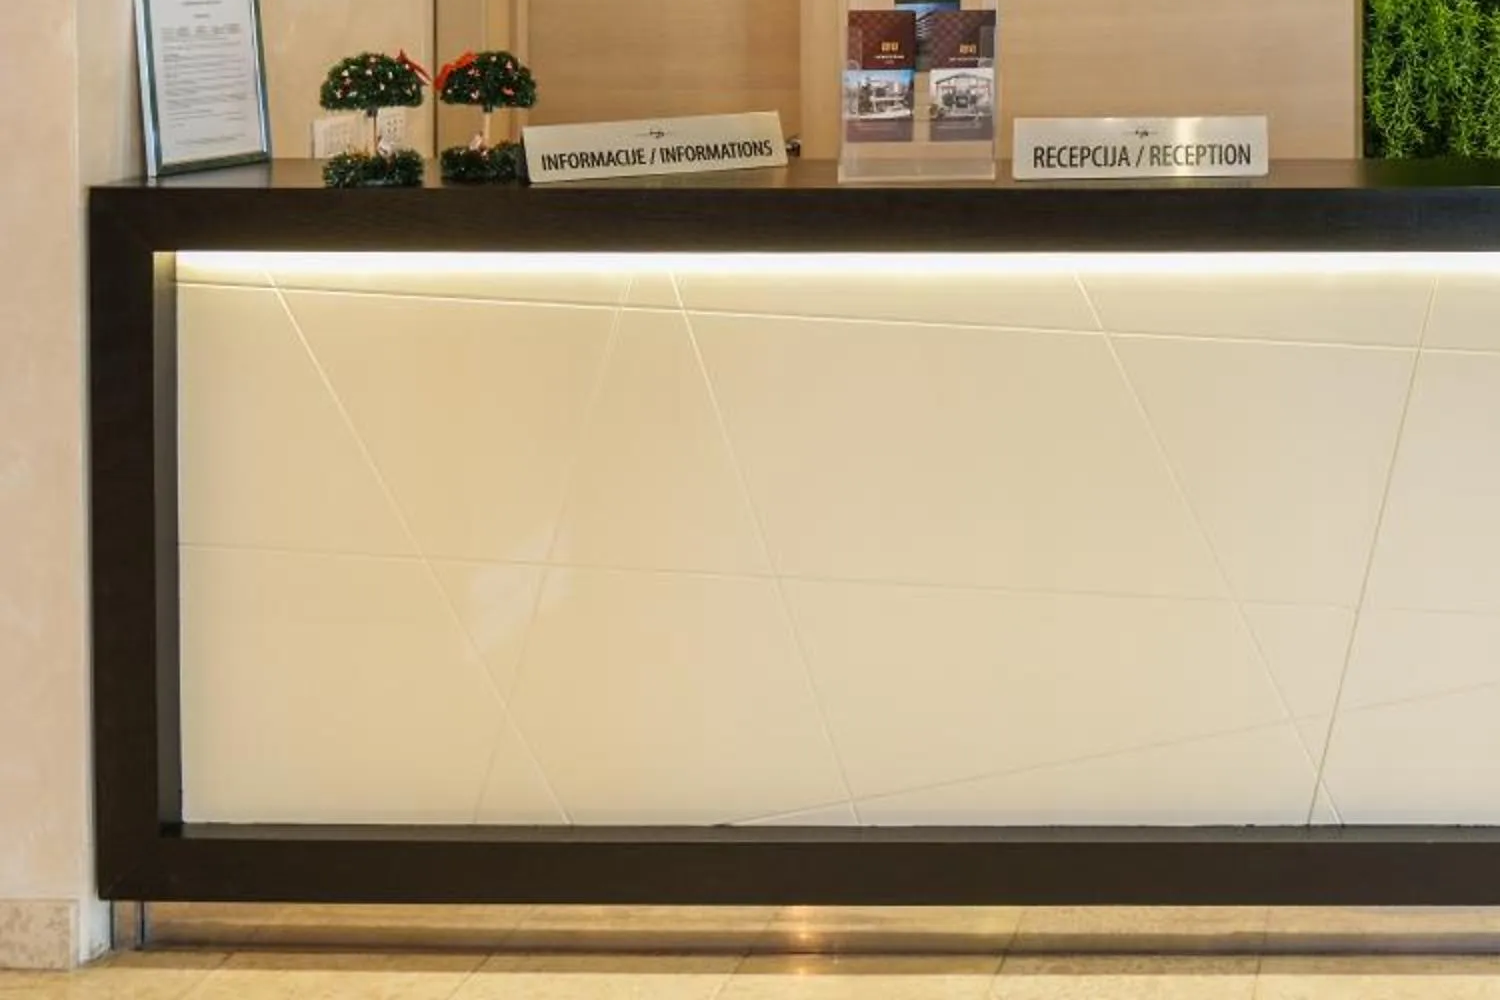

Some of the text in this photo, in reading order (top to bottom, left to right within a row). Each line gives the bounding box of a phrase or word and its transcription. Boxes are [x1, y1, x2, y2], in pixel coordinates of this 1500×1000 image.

[541, 140, 773, 171] INFORMACIJE / INFORMATIONS
[1033, 143, 1251, 168] RECEPCIJA / RECEPTION
